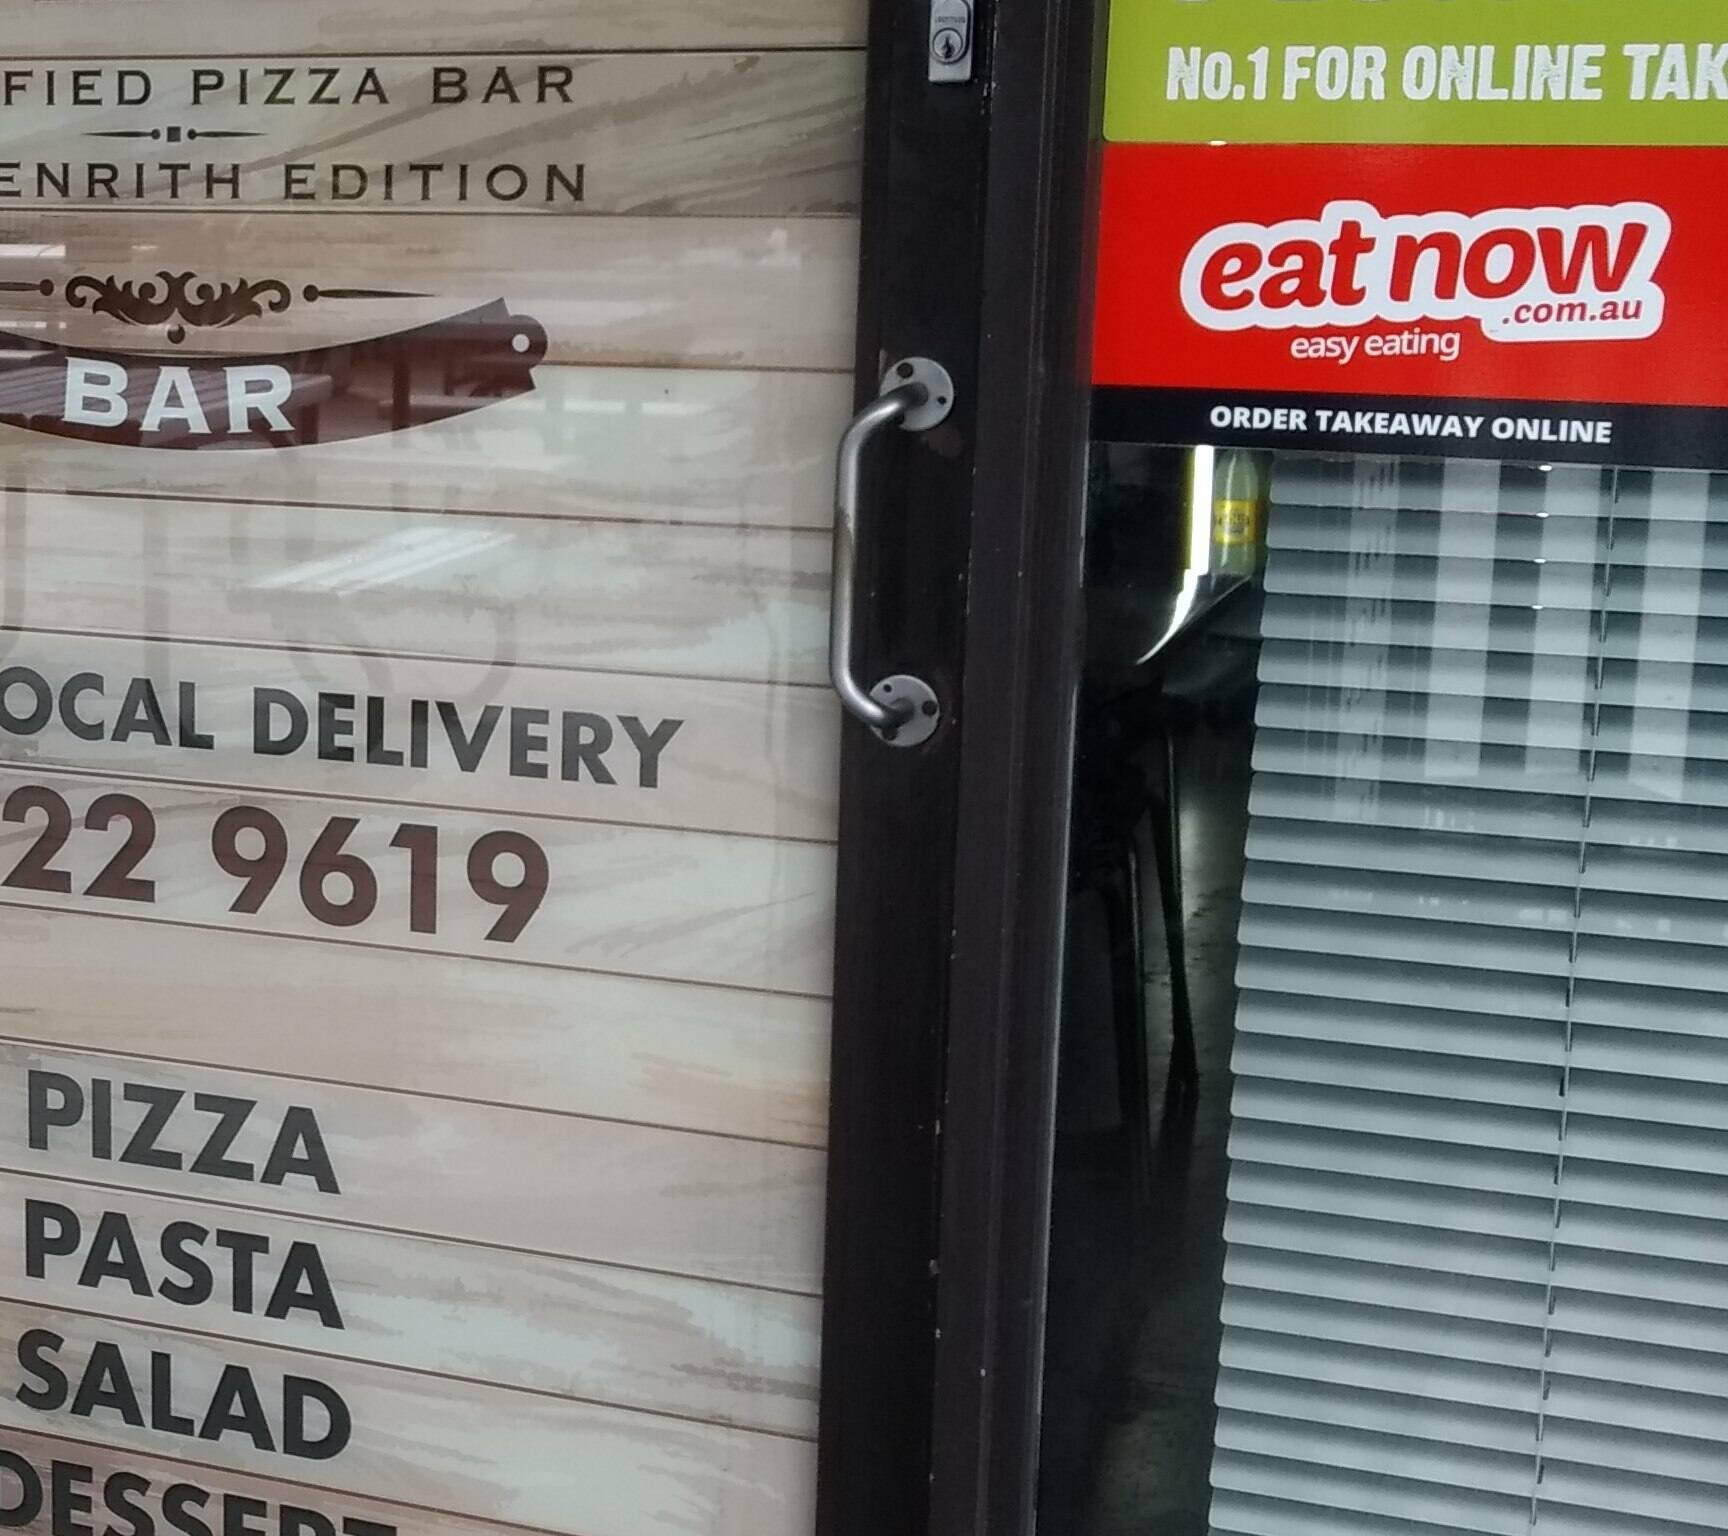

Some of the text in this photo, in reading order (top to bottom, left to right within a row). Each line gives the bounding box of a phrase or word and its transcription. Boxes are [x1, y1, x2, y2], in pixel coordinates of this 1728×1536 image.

[193, 67, 390, 105] PIZZA
[431, 65, 576, 104] BAR
[1283, 45, 1385, 101] FOR
[1402, 44, 1603, 101] ONLINE
[285, 164, 585, 203] EDITION
[1502, 297, 1643, 325] .com.au
[1290, 329, 1461, 365] easy eating
[62, 357, 296, 437] BAR
[1210, 405, 1613, 444] ORDER TAKEAWAY ONLINE
[253, 689, 685, 790] DELIVERY
[211, 805, 550, 943] 9619
[27, 1069, 341, 1195] PIZZA
[24, 1198, 345, 1330] PASTA
[15, 1328, 352, 1461] SALAD
